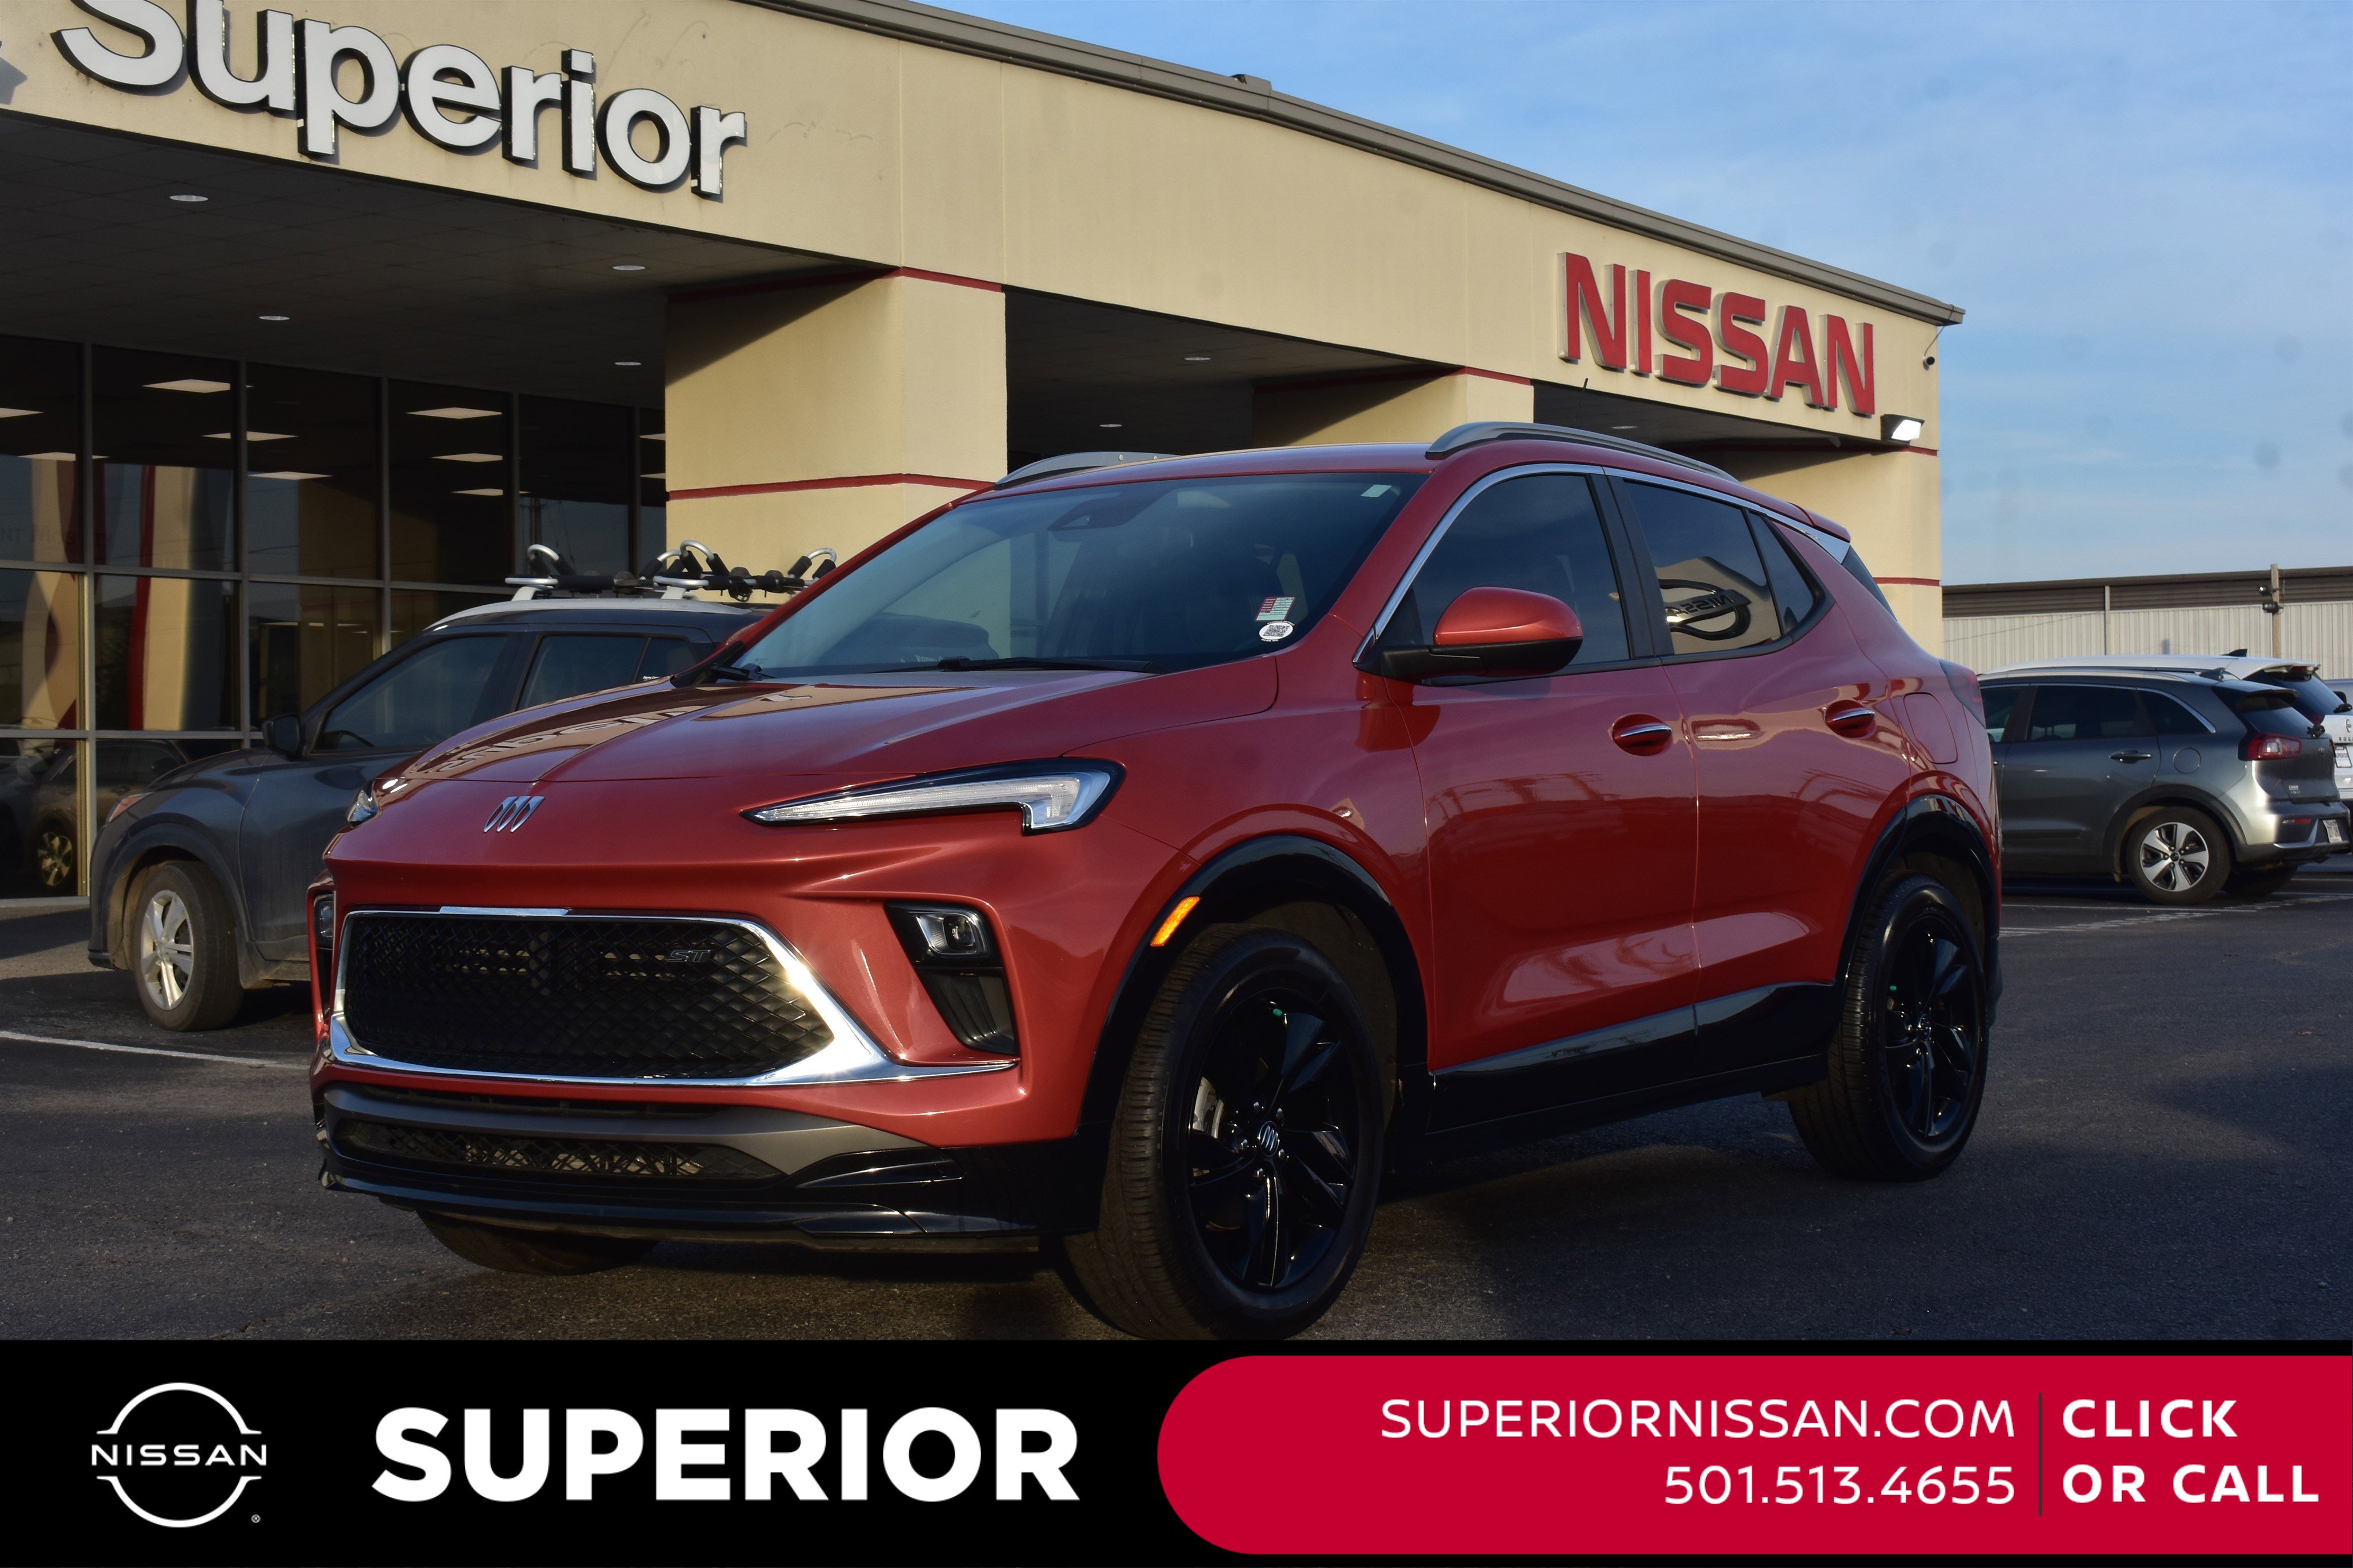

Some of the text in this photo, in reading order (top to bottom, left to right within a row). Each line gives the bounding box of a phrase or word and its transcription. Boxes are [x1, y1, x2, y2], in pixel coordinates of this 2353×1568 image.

[51, 0, 746, 195] Superior
[1557, 252, 1876, 415] NISSAN
[667, 949, 711, 963] ST
